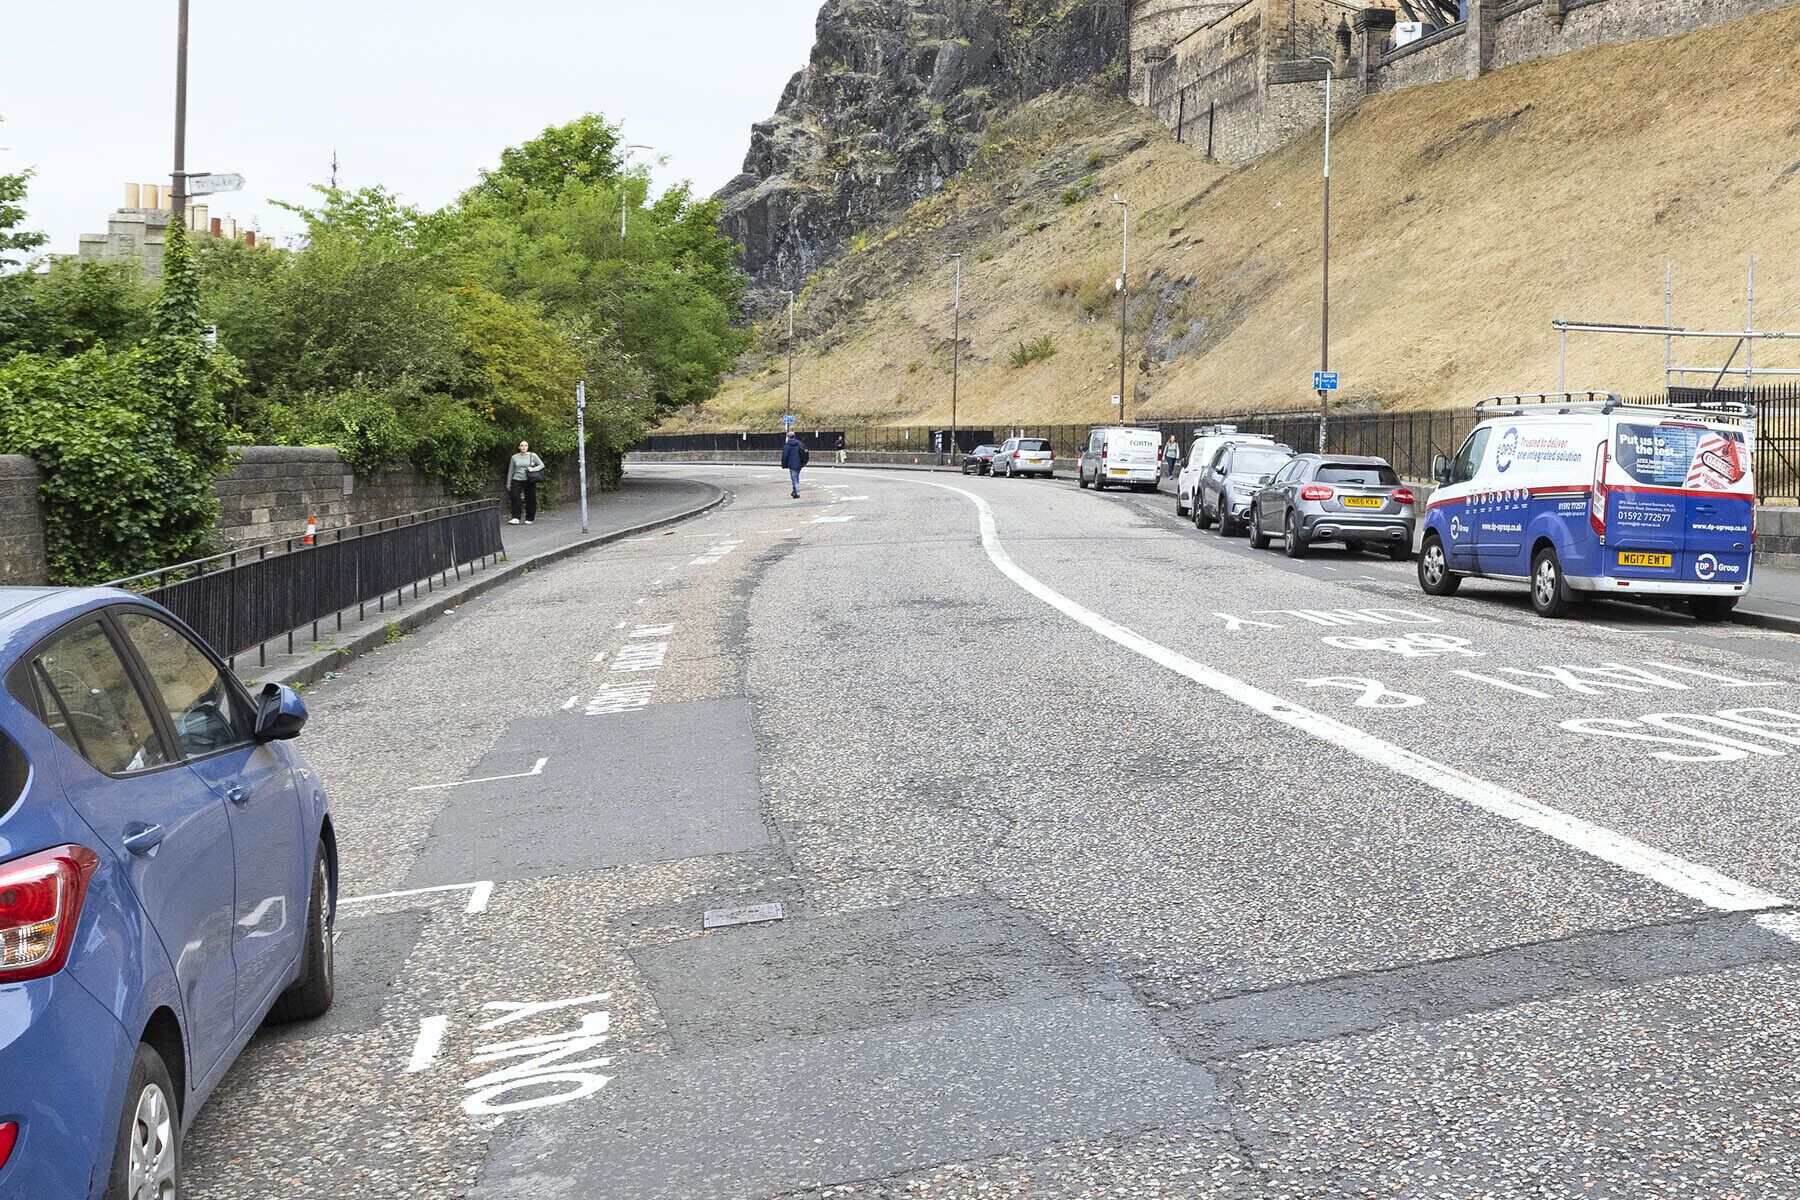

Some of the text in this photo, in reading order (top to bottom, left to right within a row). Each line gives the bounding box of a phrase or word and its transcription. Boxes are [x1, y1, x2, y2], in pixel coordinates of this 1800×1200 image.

[1520, 436, 1540, 448] Trusted
[1540, 437, 1547, 448] to
[1619, 434, 1639, 445] Put
[1640, 437, 1652, 446] us
[1654, 437, 1665, 447] to
[1635, 444, 1653, 455] the
[1517, 450, 1582, 463] one integrated solution
[1706, 453, 1735, 478] DANGER
[1558, 502, 1570, 510] 01592
[1617, 511, 1671, 522] 01592 772577
[1692, 523, 1747, 532] www.dp-sgroup.co.uk
[1718, 563, 1740, 573] Group
[1211, 608, 1446, 631] ONLY
[1449, 661, 1787, 699] TAXI
[460, 991, 617, 1115] ONLY
